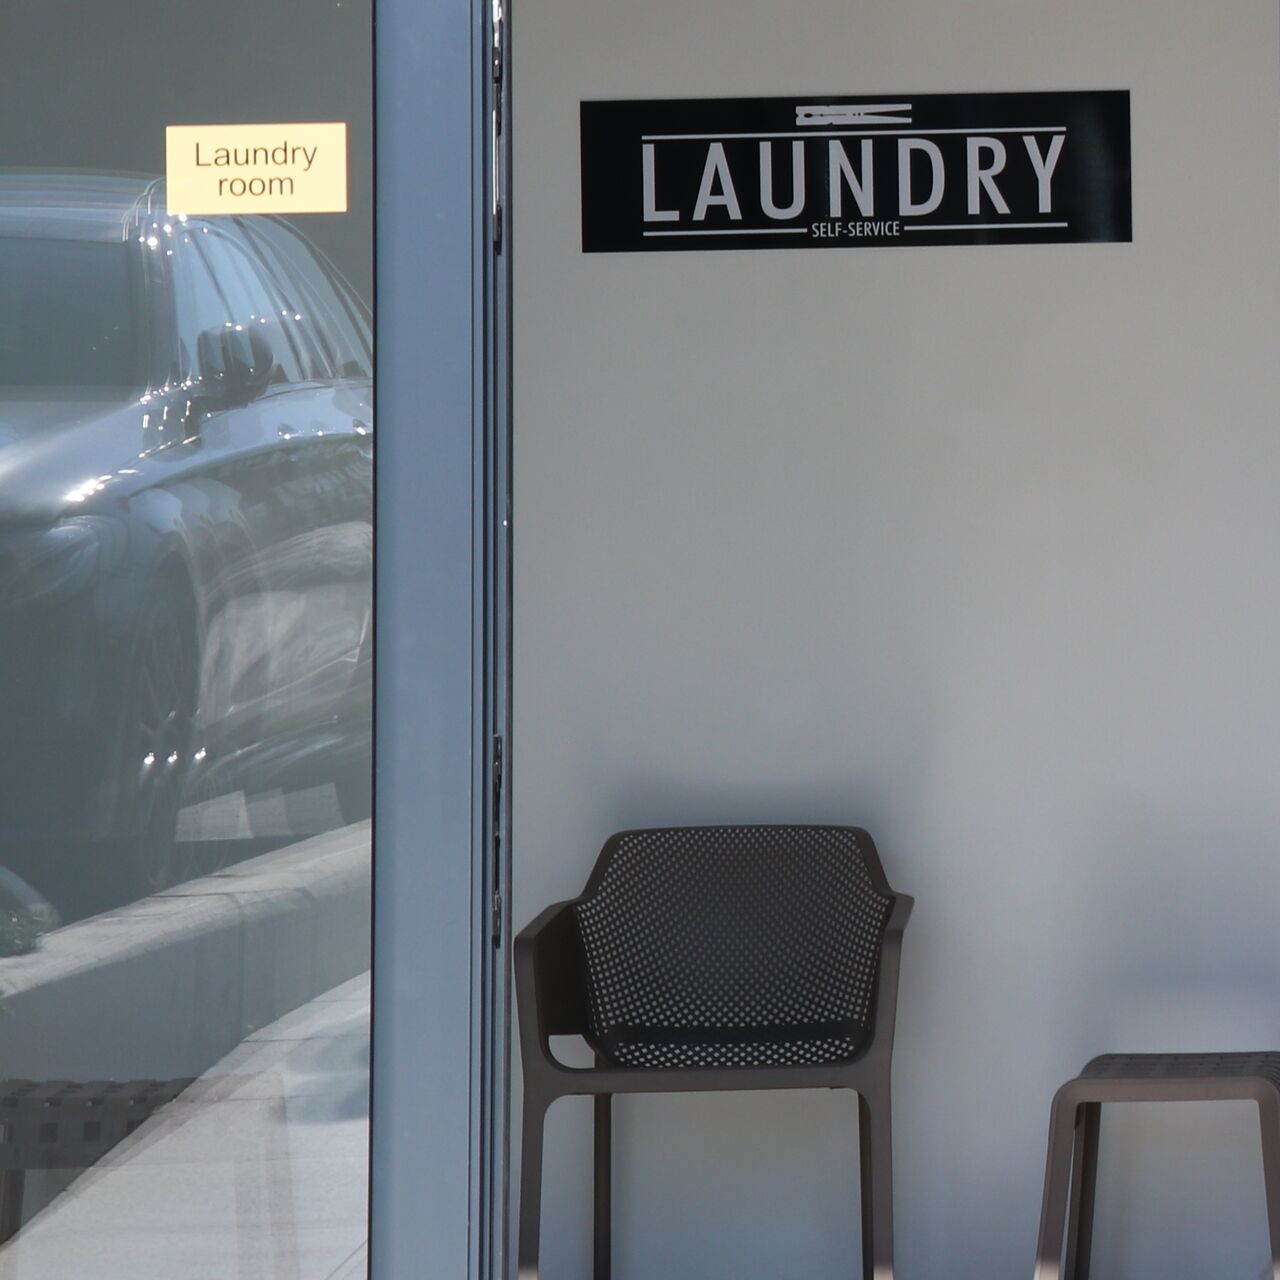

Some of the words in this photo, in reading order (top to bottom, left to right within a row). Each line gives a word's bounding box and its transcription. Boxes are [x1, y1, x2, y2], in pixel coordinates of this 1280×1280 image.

[195, 140, 318, 172] Laundry
[218, 176, 294, 197] room
[642, 134, 1066, 222] LAUNDRY
[812, 220, 900, 238] SELF-SERVICE
